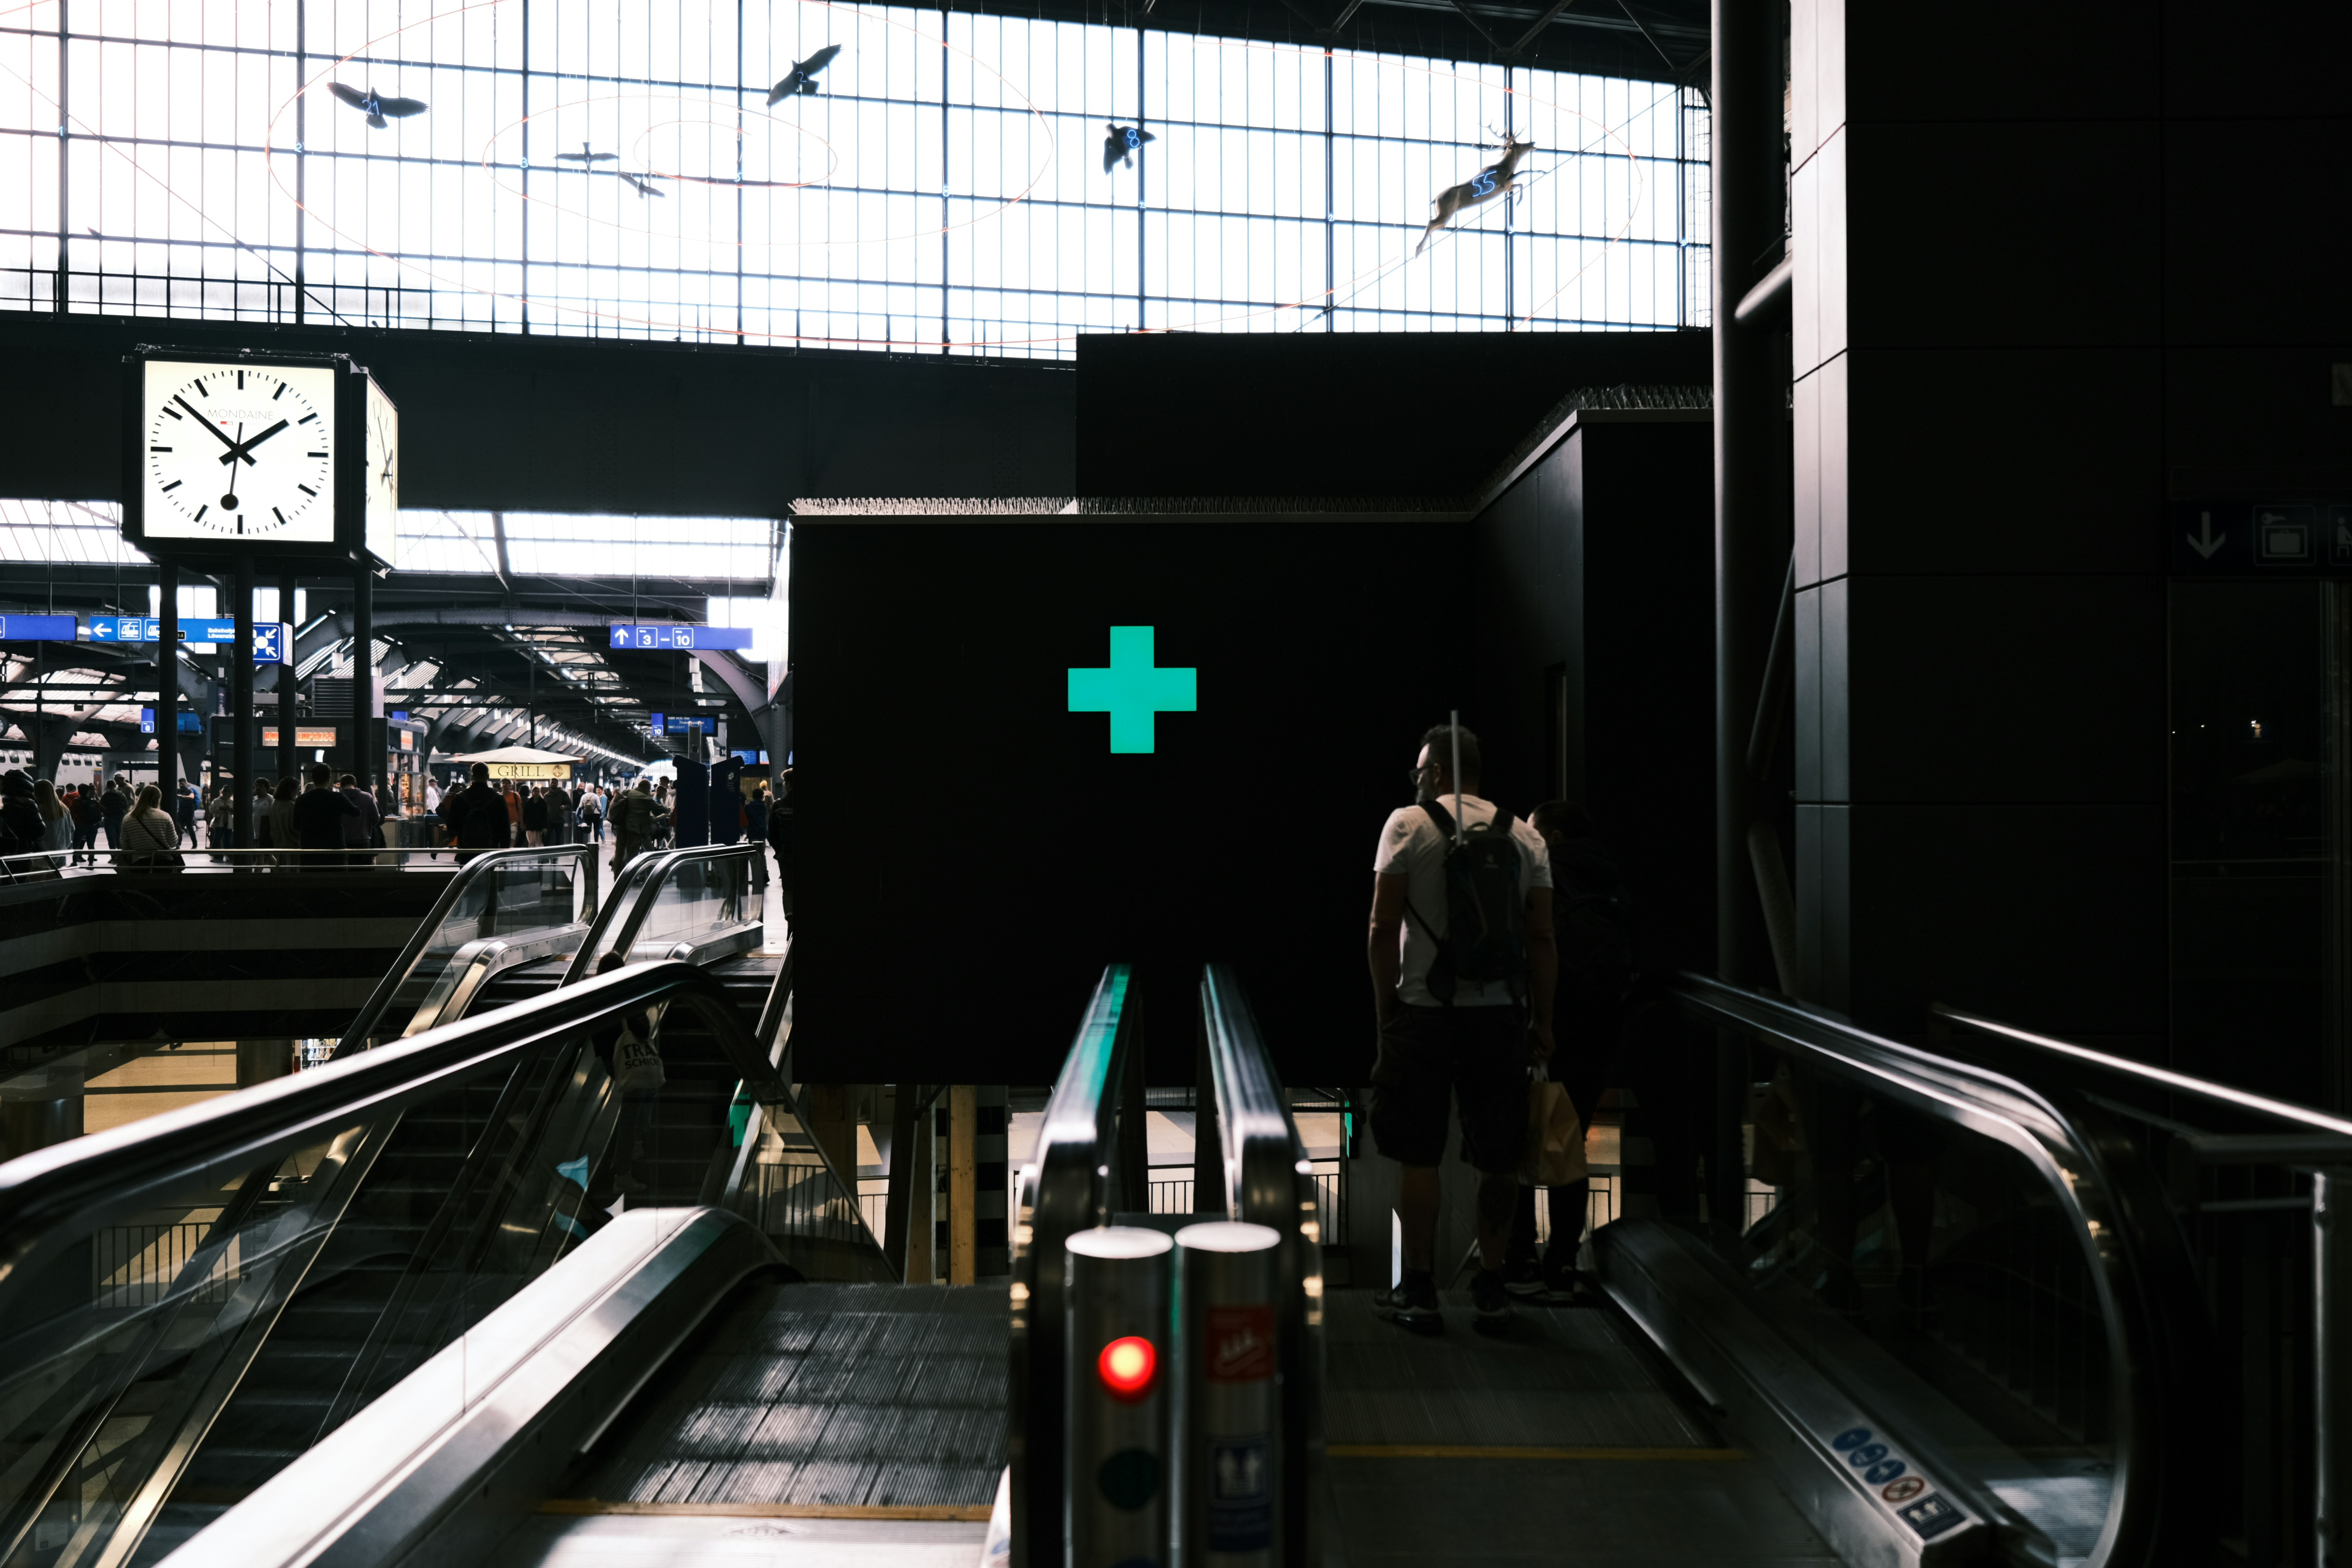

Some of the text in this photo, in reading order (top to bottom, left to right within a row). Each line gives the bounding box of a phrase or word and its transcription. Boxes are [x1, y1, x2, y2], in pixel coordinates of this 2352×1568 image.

[797, 71, 807, 82] 2
[362, 100, 380, 115] 21
[1127, 130, 1140, 147] 8
[520, 158, 528, 168] 3
[1472, 170, 1497, 197] 55
[943, 186, 949, 197] 8
[207, 409, 273, 420] MONDAINE
[643, 635, 651, 645] 3
[676, 635, 690, 646] 10
[265, 732, 335, 742] BU EXPRESS
[498, 766, 545, 778] GRILL
